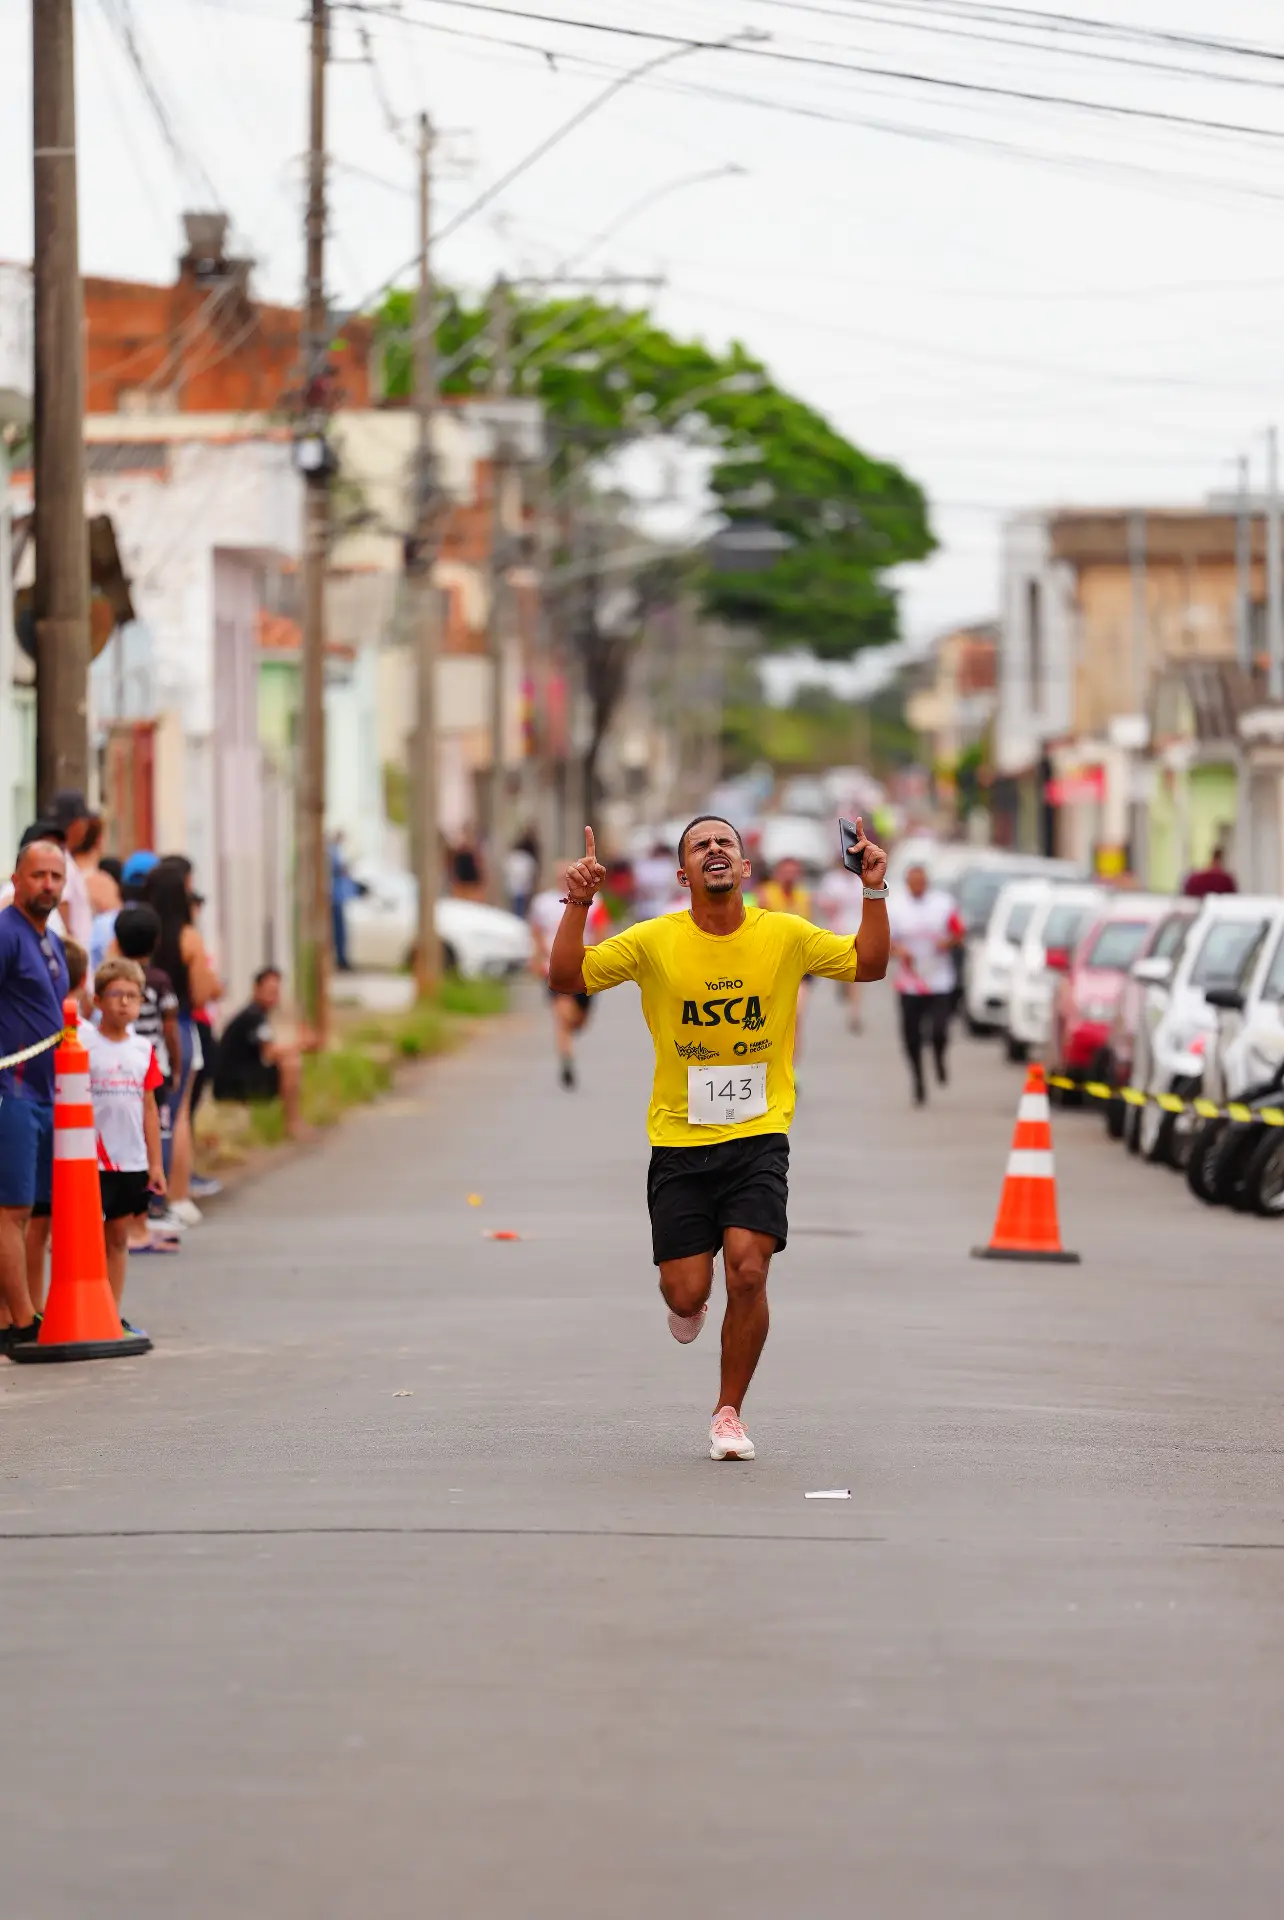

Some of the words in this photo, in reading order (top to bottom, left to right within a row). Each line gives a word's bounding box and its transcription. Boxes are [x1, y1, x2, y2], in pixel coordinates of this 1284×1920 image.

[705, 979, 743, 991] YoPRO
[682, 996, 761, 1026] ASCA
[741, 1014, 766, 1032] RUN
[705, 1078, 752, 1102] 143
